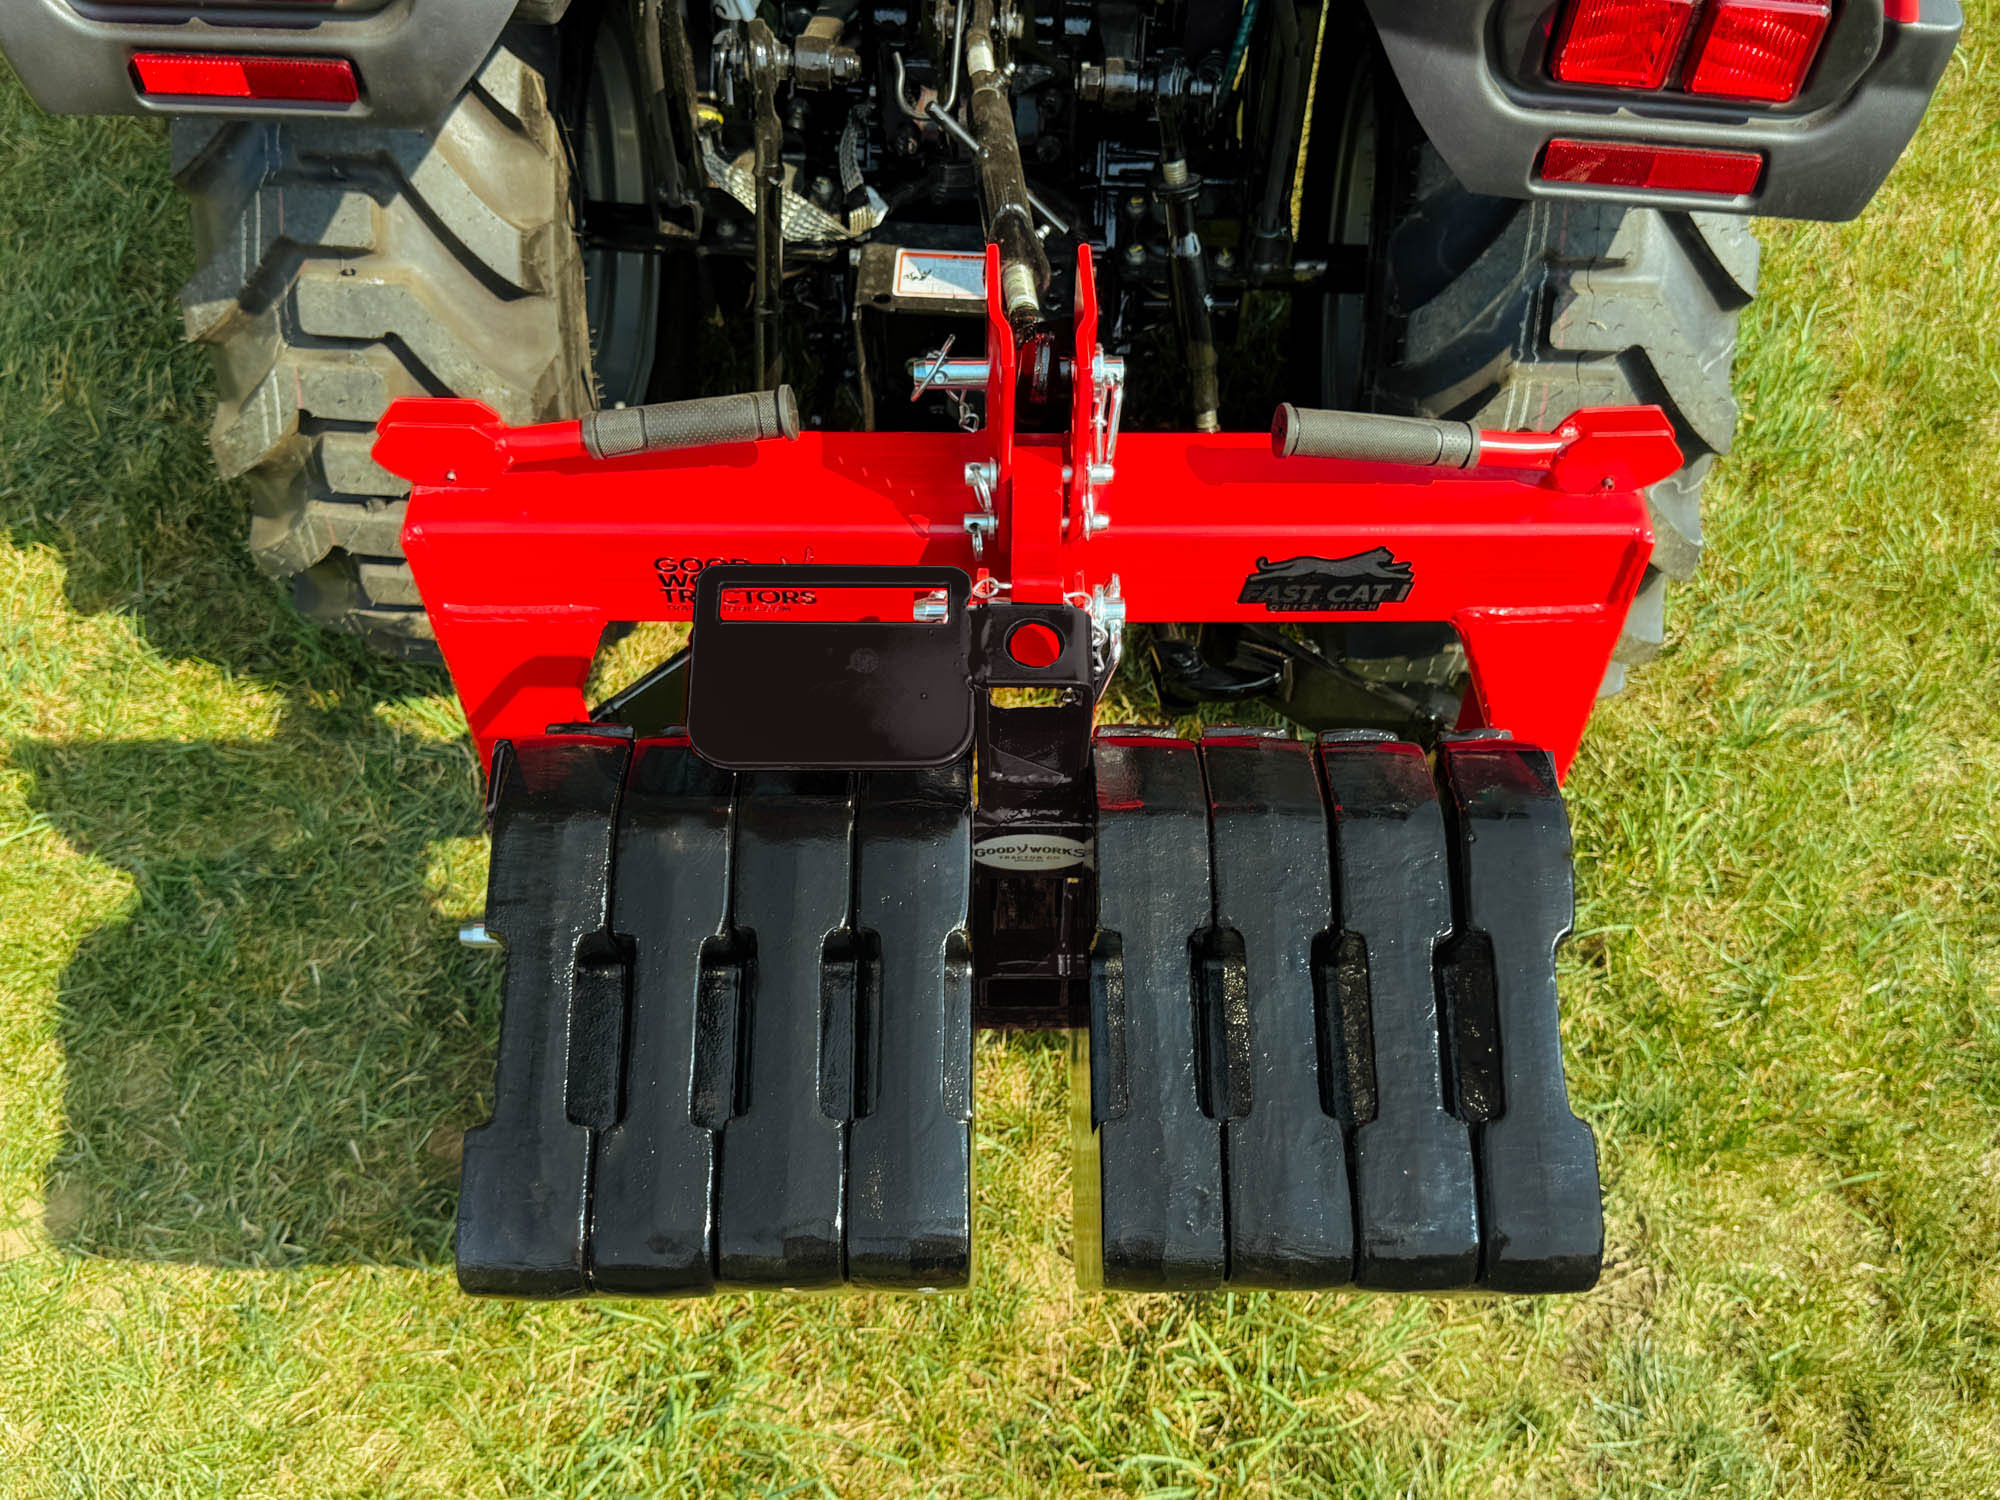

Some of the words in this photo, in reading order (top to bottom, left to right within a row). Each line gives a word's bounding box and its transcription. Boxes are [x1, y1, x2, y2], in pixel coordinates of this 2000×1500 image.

[1242, 583, 1322, 602] FAST
[1326, 583, 1393, 602] CAT
[1269, 603, 1320, 612] QUICK
[1328, 603, 1378, 612] HITCH
